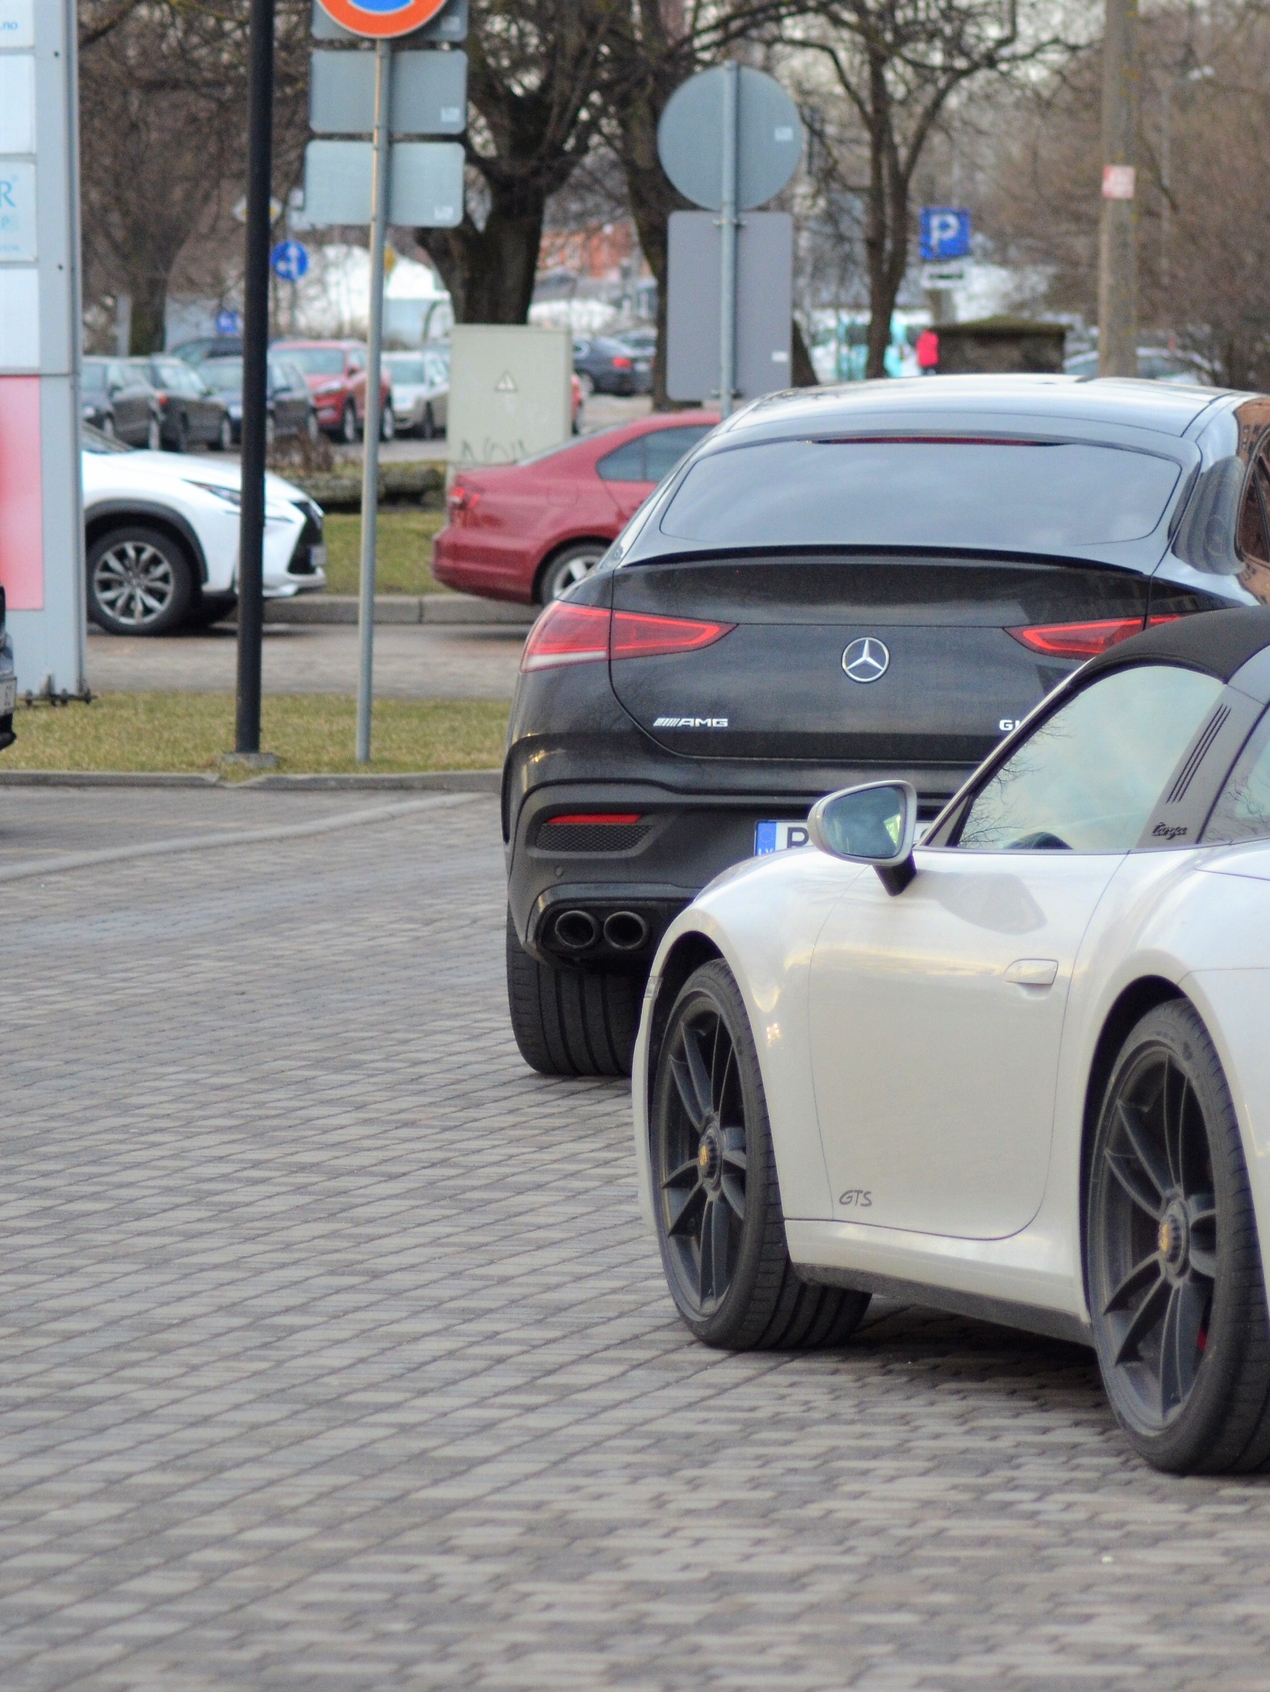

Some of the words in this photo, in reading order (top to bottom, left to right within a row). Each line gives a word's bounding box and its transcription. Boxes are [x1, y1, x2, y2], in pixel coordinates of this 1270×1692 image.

[930, 214, 959, 248] P
[677, 718, 728, 727] AMG
[839, 1189, 872, 1207] GTS
